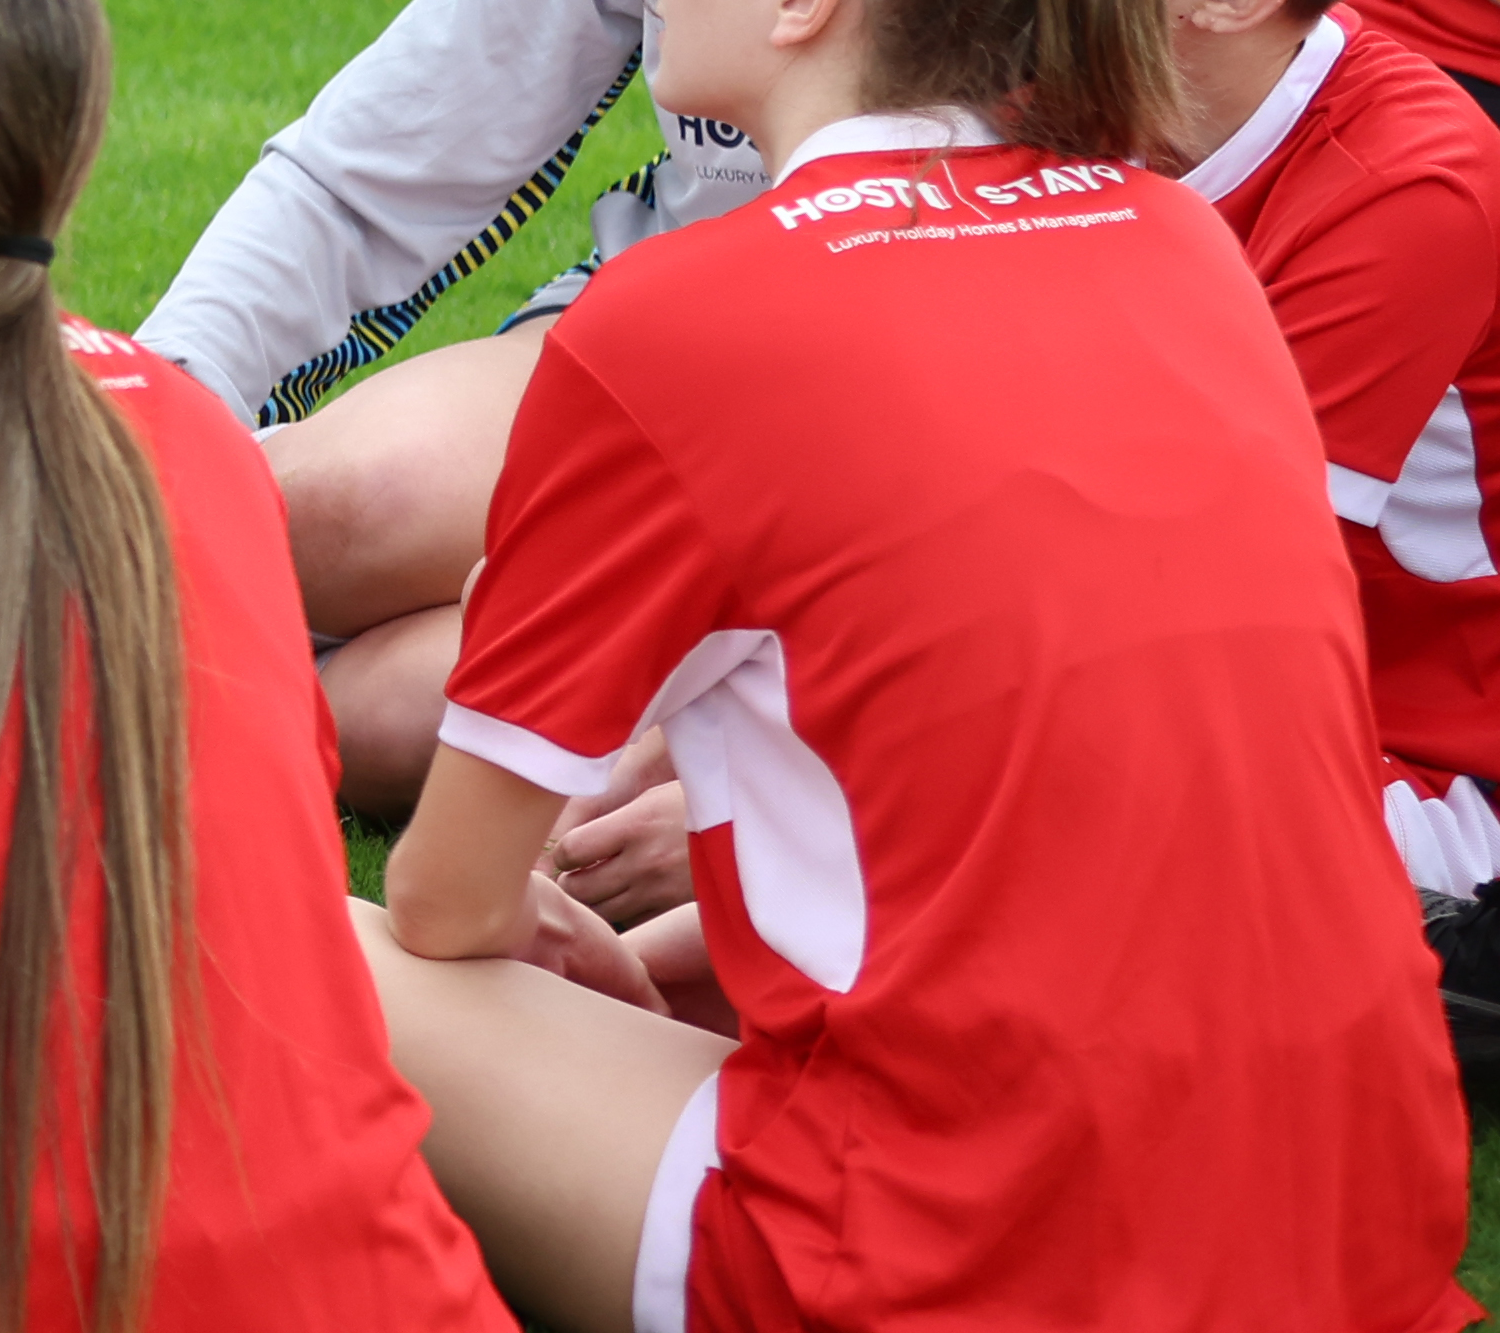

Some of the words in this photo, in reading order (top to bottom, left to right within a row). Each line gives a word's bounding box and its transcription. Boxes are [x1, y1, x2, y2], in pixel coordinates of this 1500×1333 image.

[696, 165, 755, 184] LUXURY
[827, 229, 890, 254] Luxury
[957, 217, 1017, 236] Homes
[1019, 217, 1033, 231] &
[1035, 207, 1138, 231] Management
